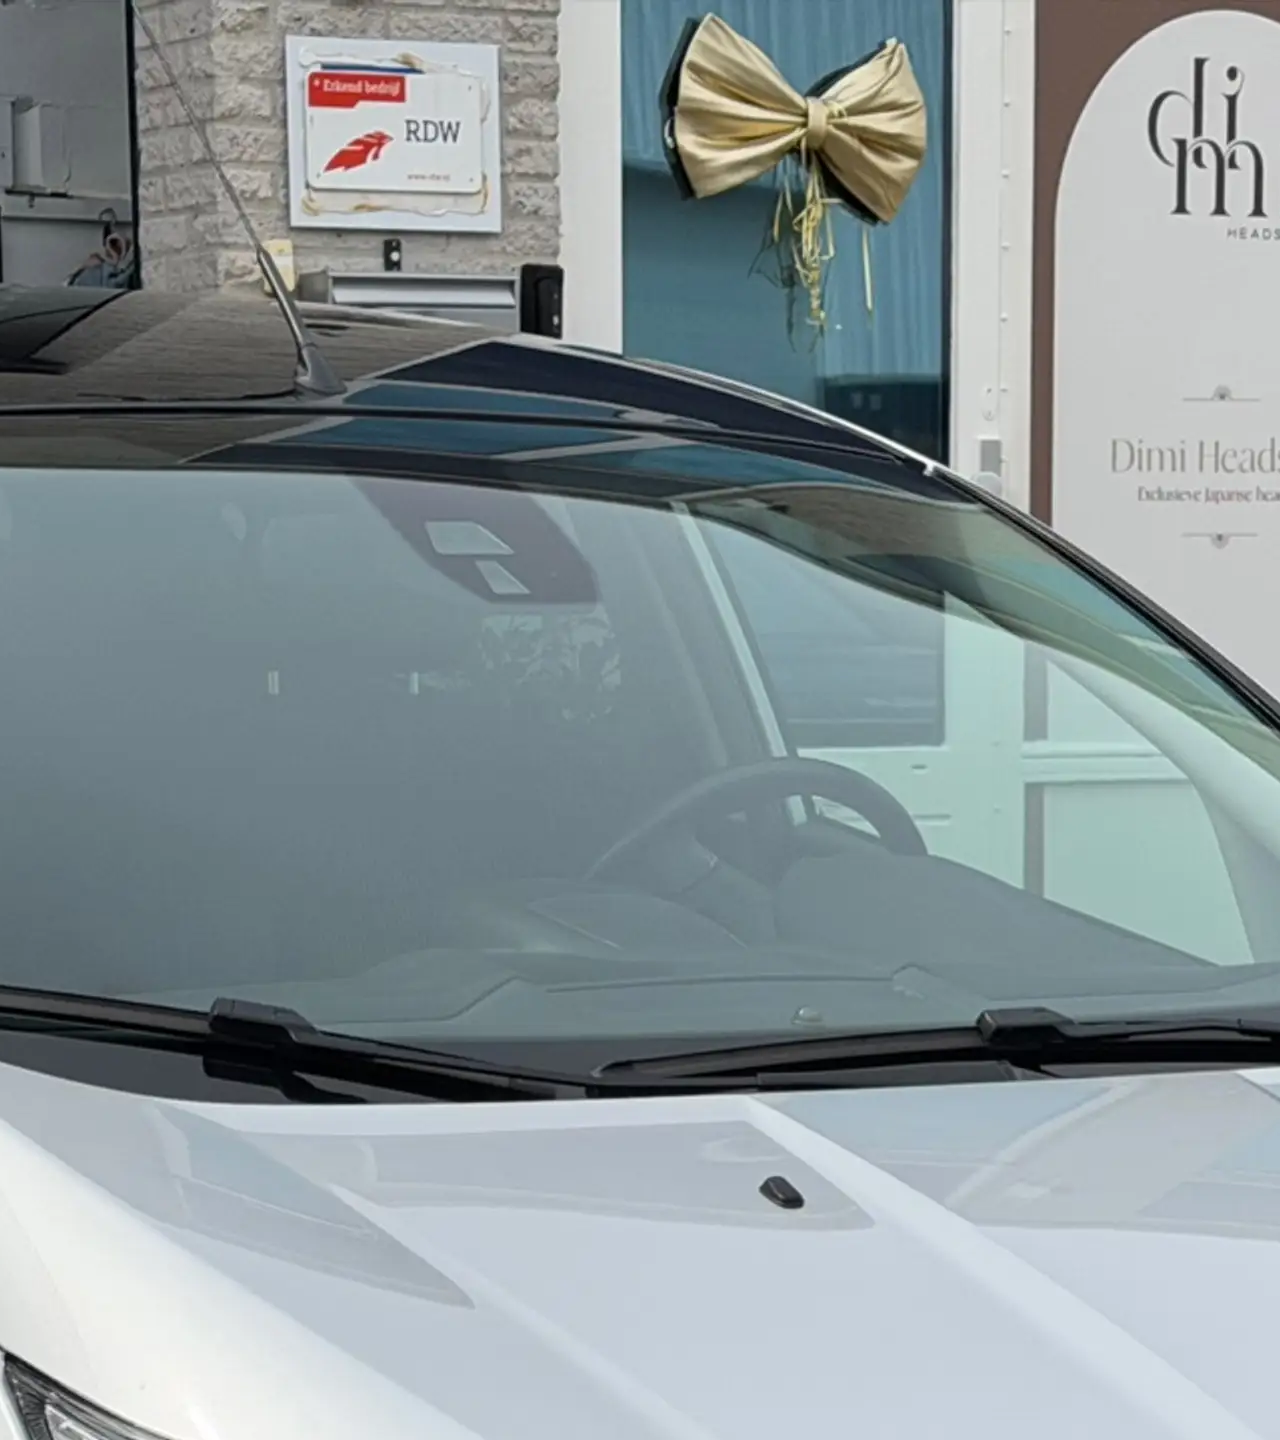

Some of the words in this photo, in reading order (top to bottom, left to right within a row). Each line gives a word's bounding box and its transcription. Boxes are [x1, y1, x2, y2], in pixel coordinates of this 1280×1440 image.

[323, 79, 363, 94] Erkend
[405, 119, 460, 144] RDW
[1111, 438, 1186, 473] Dimi
